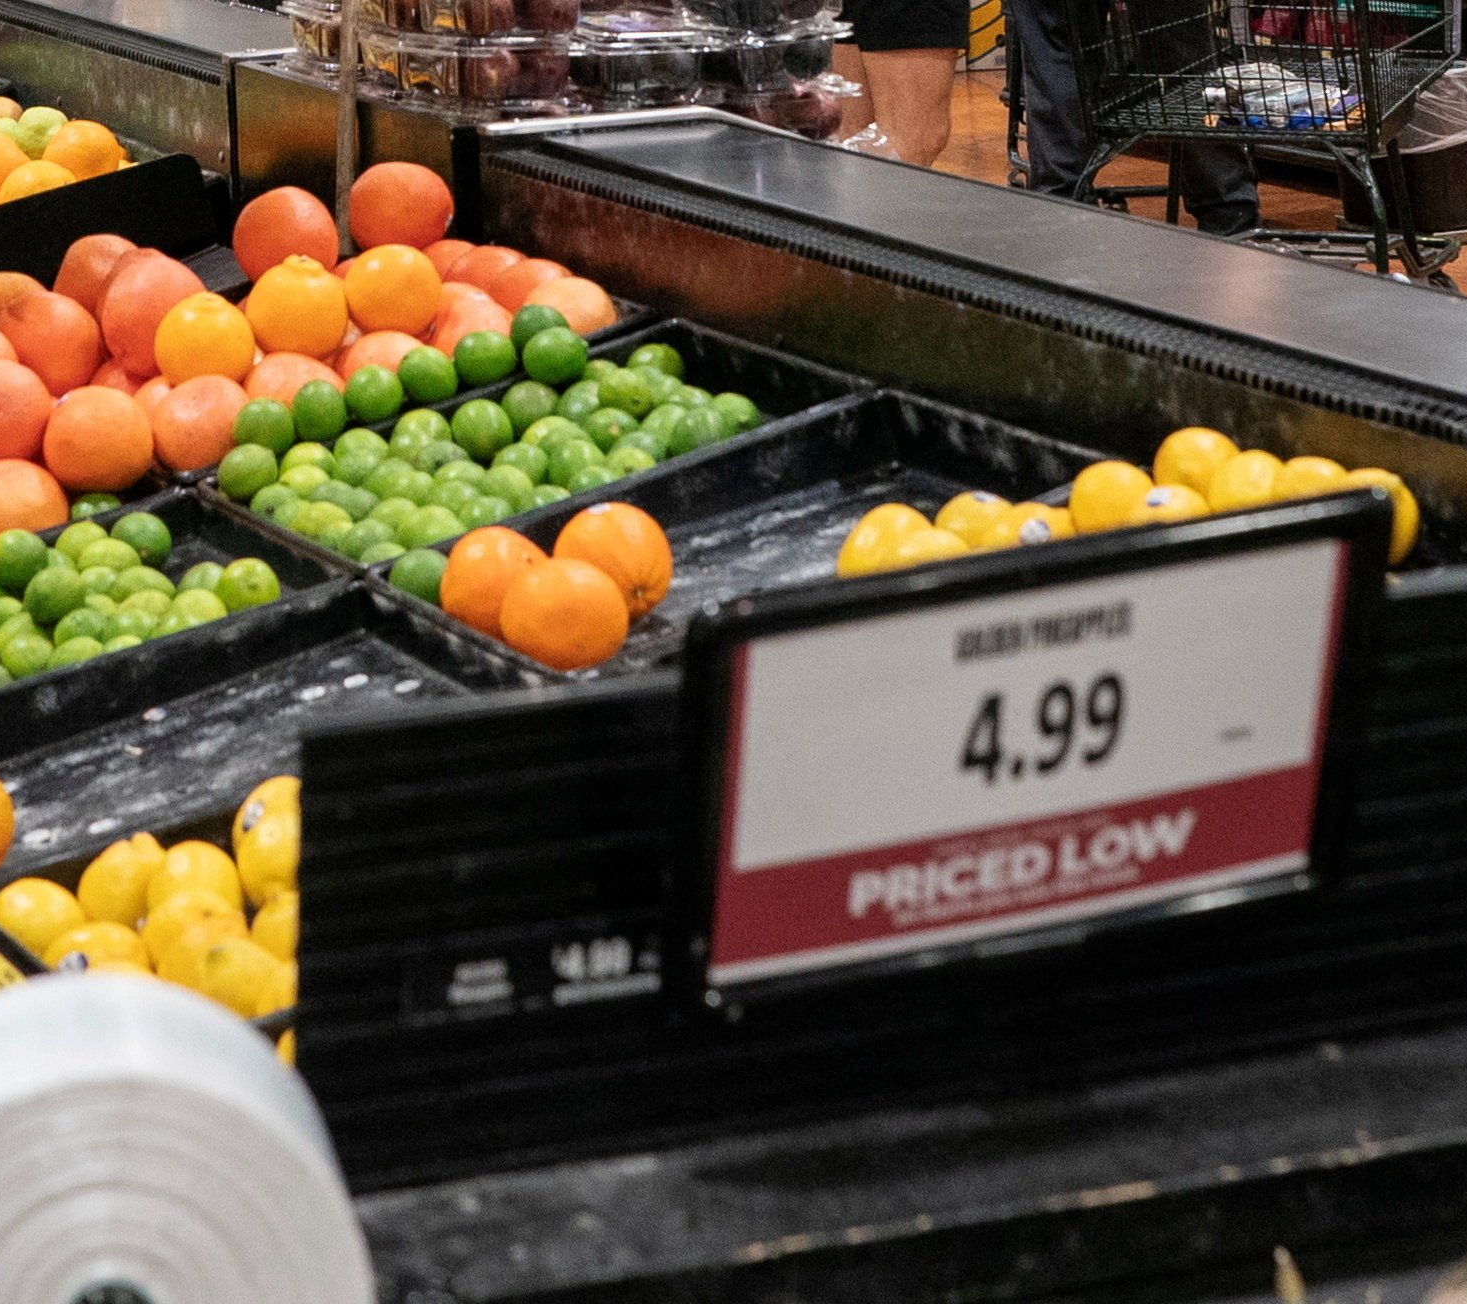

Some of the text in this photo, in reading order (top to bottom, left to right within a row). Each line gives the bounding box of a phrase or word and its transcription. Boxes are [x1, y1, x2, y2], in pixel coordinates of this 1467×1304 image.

[959, 668, 1125, 788] 4.99
[846, 806, 1198, 920] PRICED LOW
